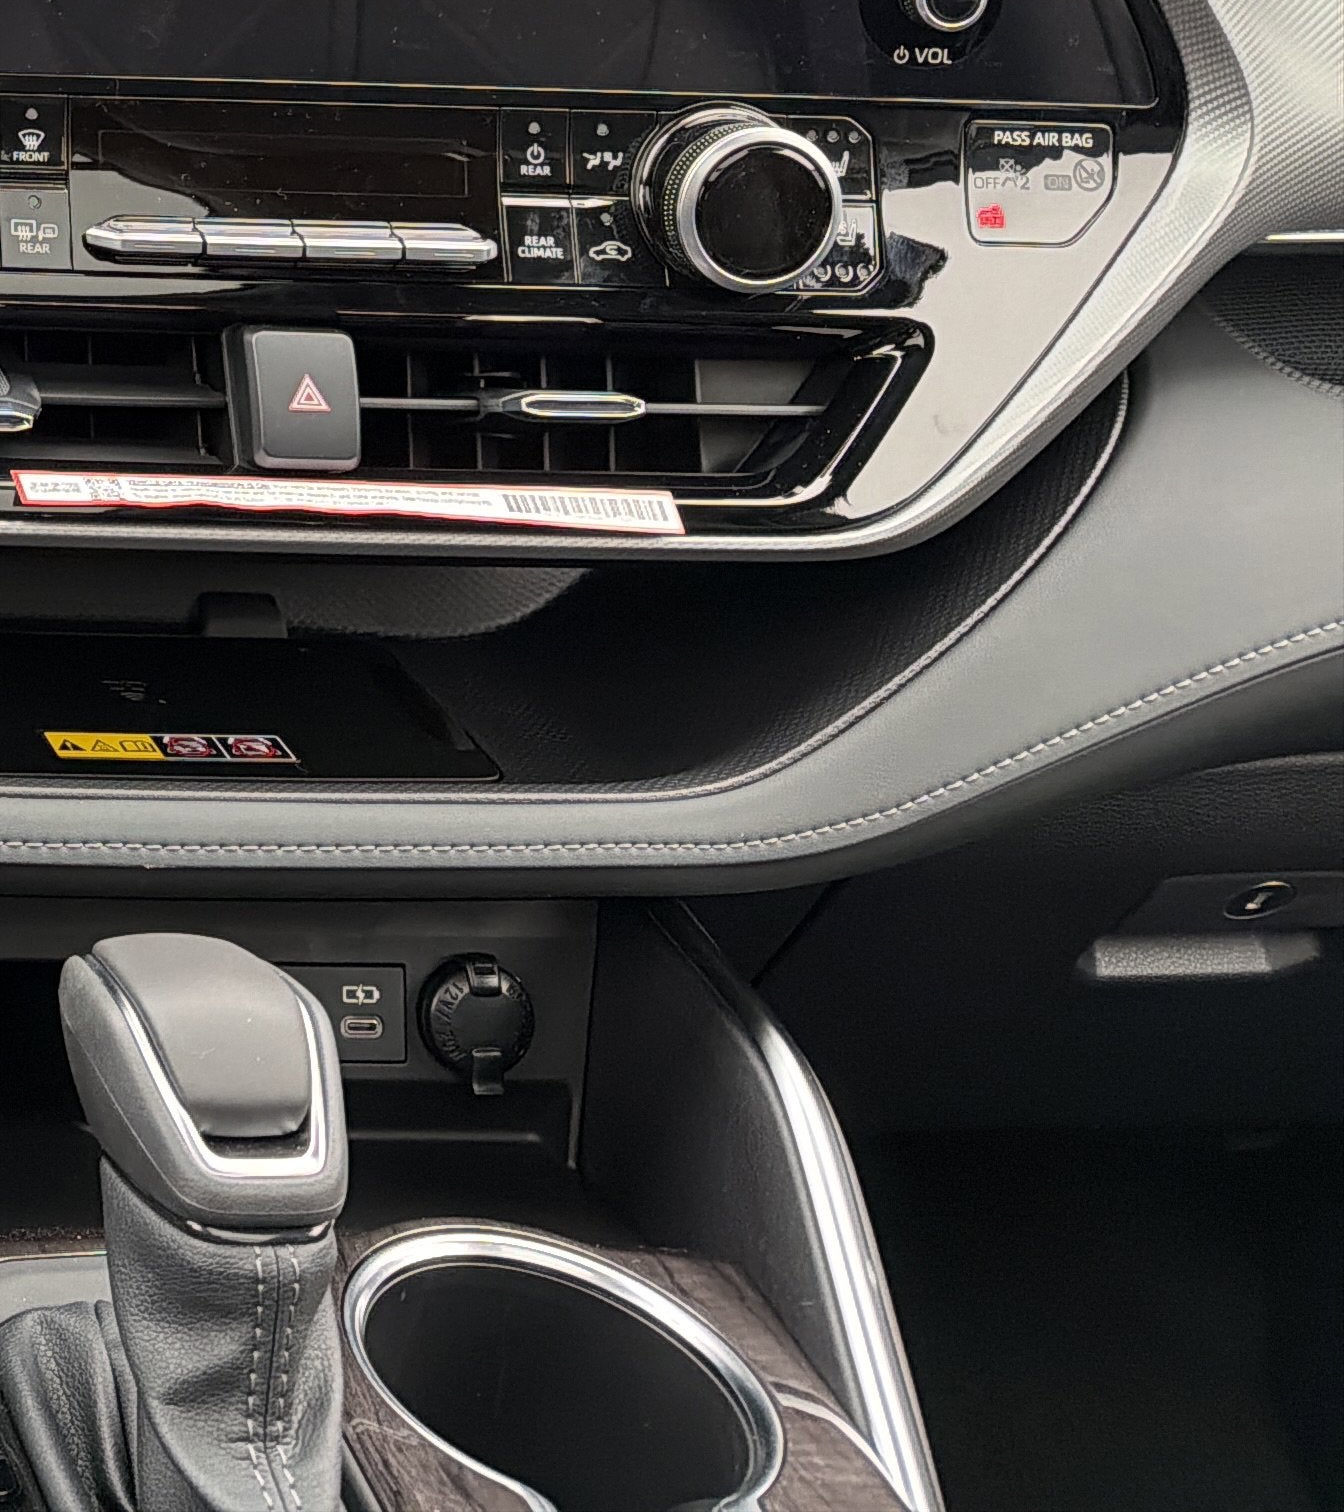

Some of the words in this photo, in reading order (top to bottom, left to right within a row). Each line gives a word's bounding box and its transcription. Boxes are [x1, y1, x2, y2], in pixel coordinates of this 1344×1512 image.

[915, 47, 952, 64] VOL
[994, 131, 1030, 146] PASS
[1033, 132, 1059, 147] AIR
[1062, 133, 1093, 148] BAG
[13, 150, 50, 162] FRONT
[520, 164, 551, 176] REAR
[974, 176, 1001, 190] OFF
[19, 241, 50, 254] REAR
[524, 235, 555, 247] REAR
[517, 246, 564, 259] CLIMATE
